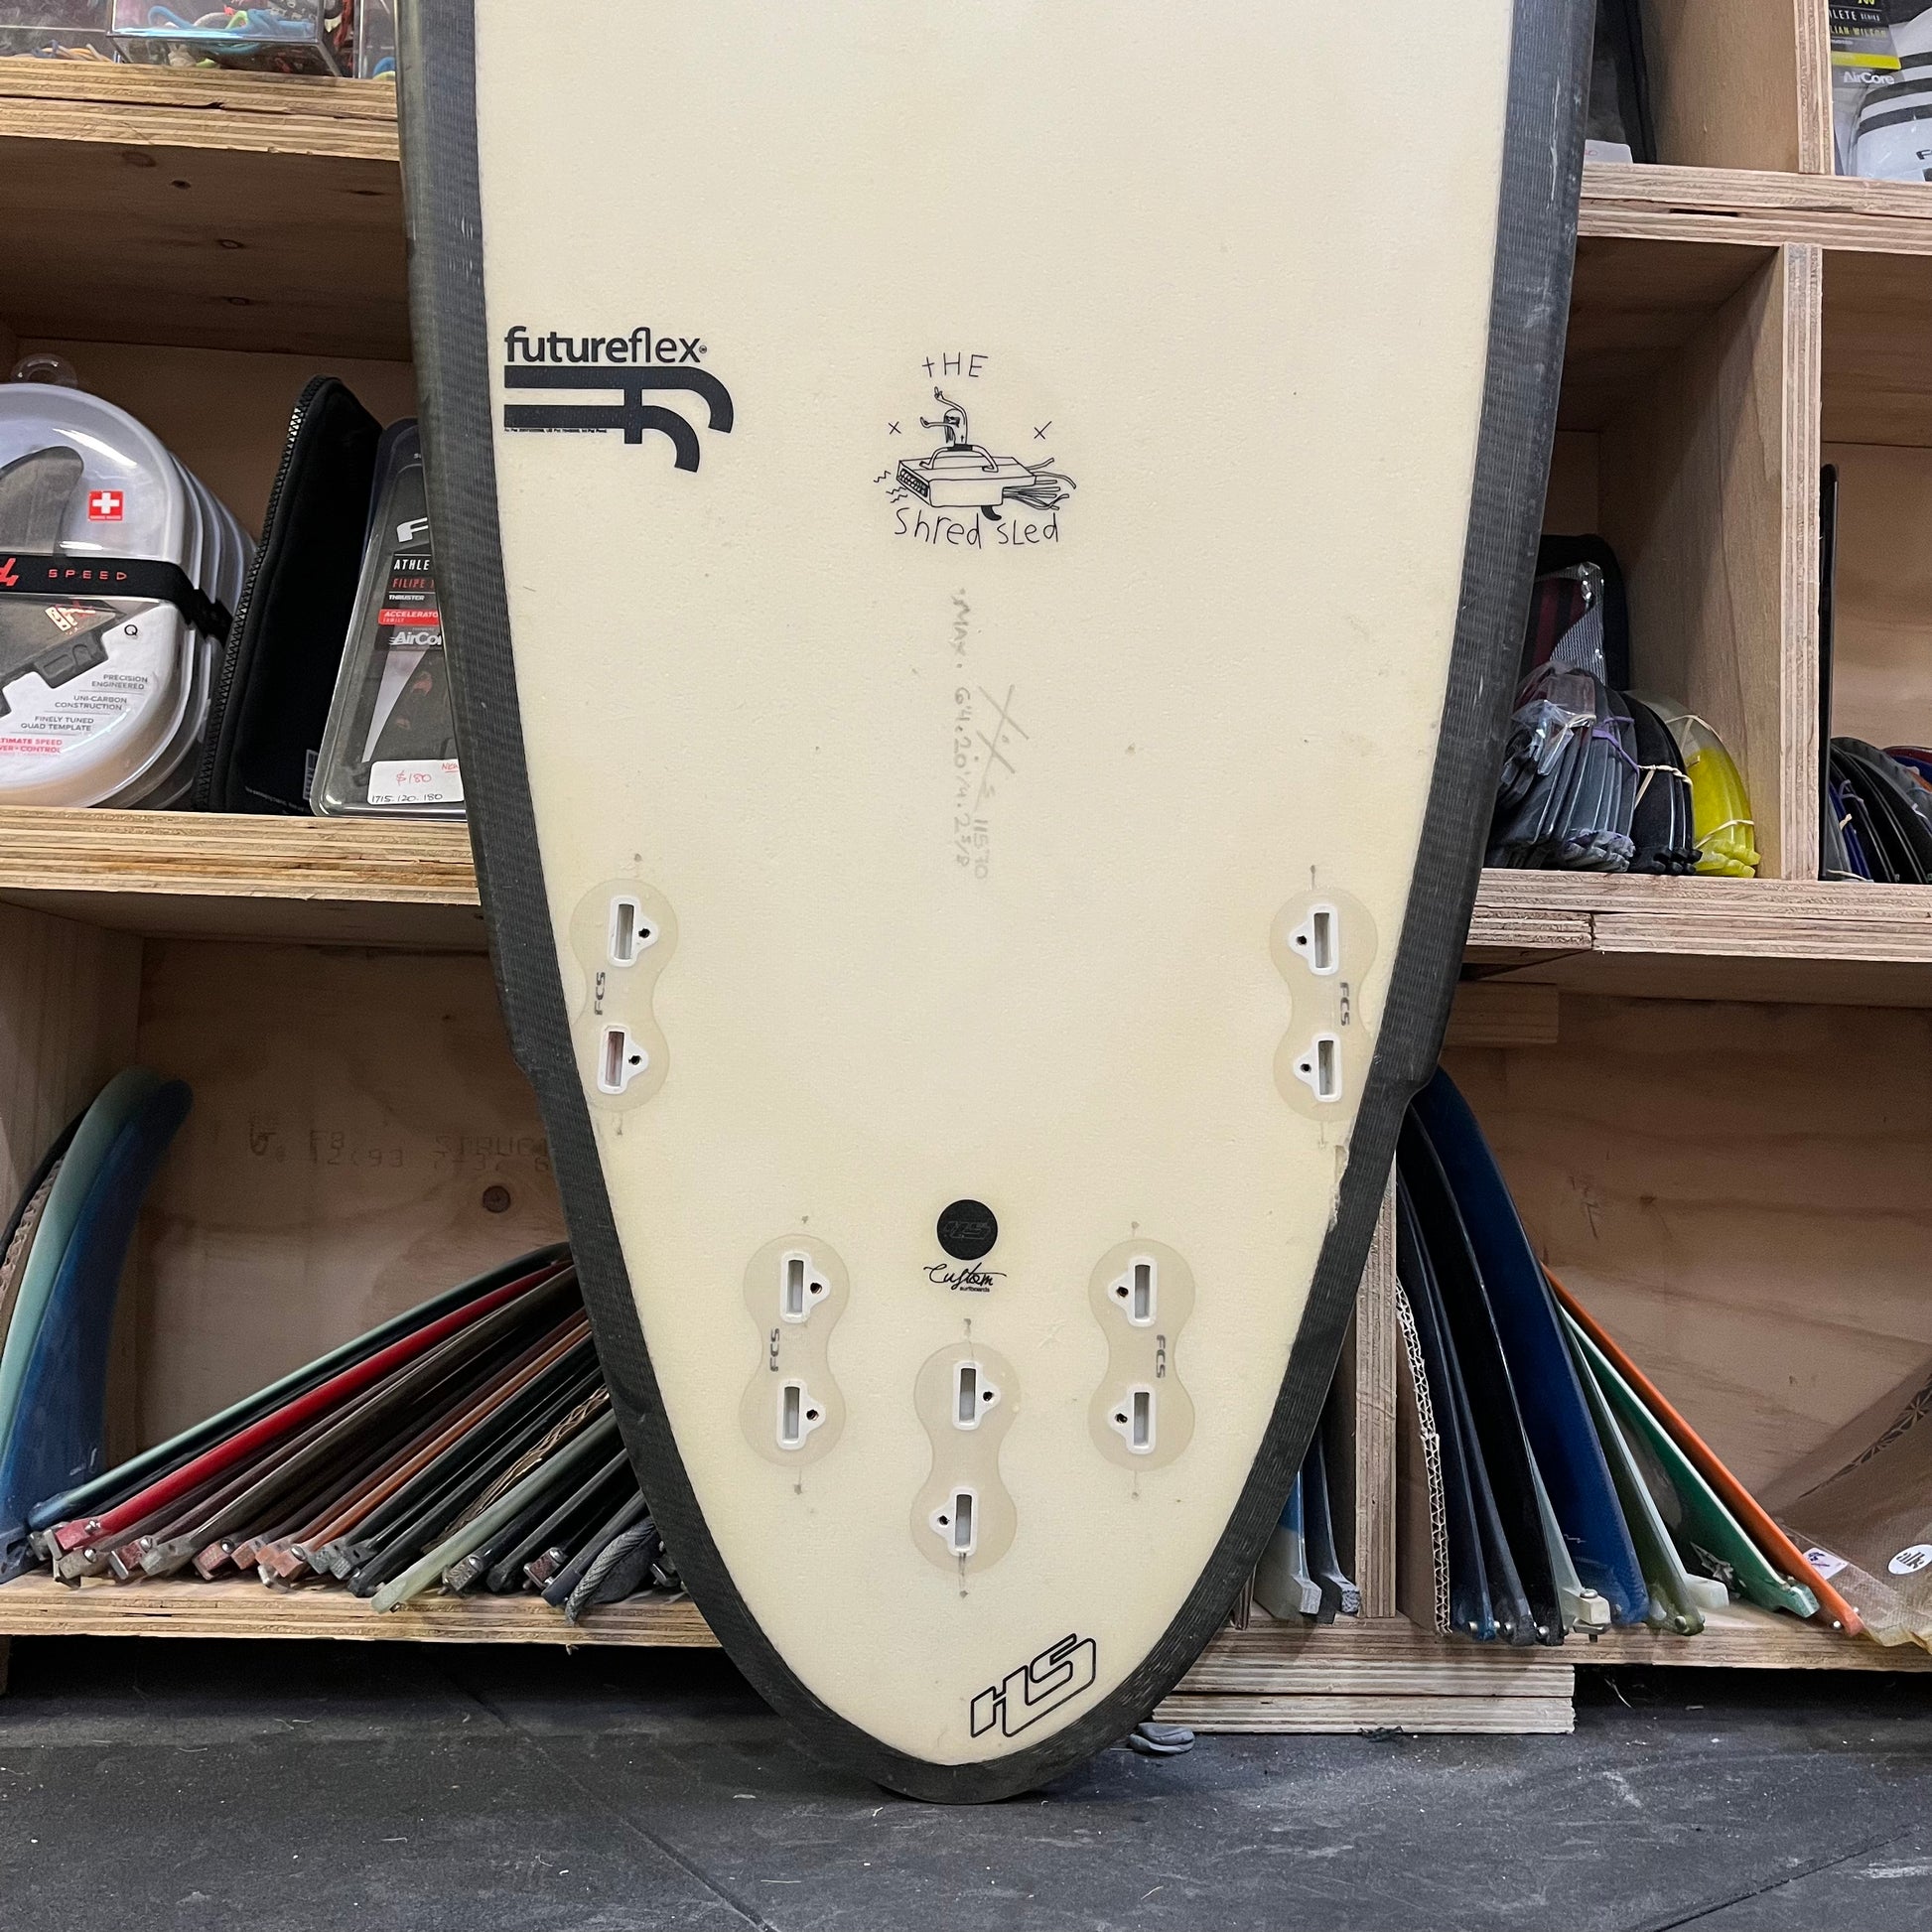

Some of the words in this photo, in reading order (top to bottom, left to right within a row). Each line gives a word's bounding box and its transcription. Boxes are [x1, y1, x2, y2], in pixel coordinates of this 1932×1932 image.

[1843, 70, 1895, 85] AirCore
[895, 507, 982, 550] Shred
[48, 569, 128, 581] SPEED
[392, 578, 426, 589] FILIPE
[124, 623, 139, 637] Q
[103, 673, 149, 683] PRECISION
[91, 680, 145, 691] ENGINEERED
[55, 701, 122, 711] CONSTRUCTION
[73, 695, 128, 704] UNI-CARBON
[34, 715, 63, 724] FINELY
[20, 722, 47, 731] QUAD
[49, 723, 92, 732] TEMPLATE
[397, 769, 432, 786] $180
[595, 971, 606, 1016] FCS
[1339, 981, 1350, 1027] FCS
[922, 1261, 1008, 1291] Custom
[769, 1327, 780, 1372] FCS
[1155, 1334, 1167, 1379] FCS
